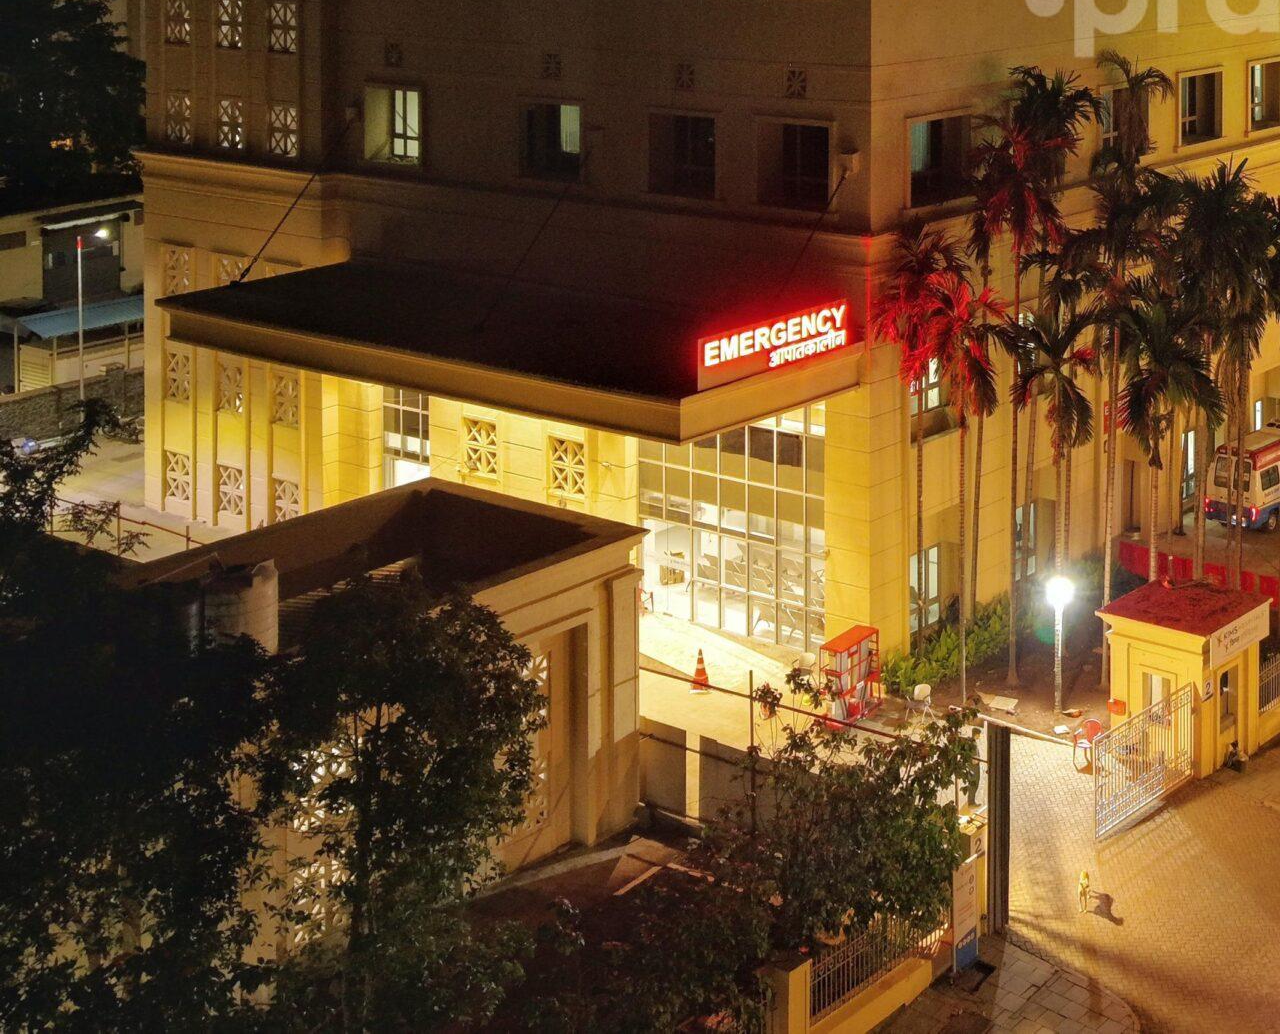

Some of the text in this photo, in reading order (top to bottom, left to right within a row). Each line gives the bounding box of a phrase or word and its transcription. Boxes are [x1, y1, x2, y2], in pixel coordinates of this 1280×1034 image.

[704, 305, 846, 366] EMERGENCY
[769, 329, 846, 368] आपातकालीन
[1205, 681, 1211, 695] 2
[975, 838, 982, 852] 2
